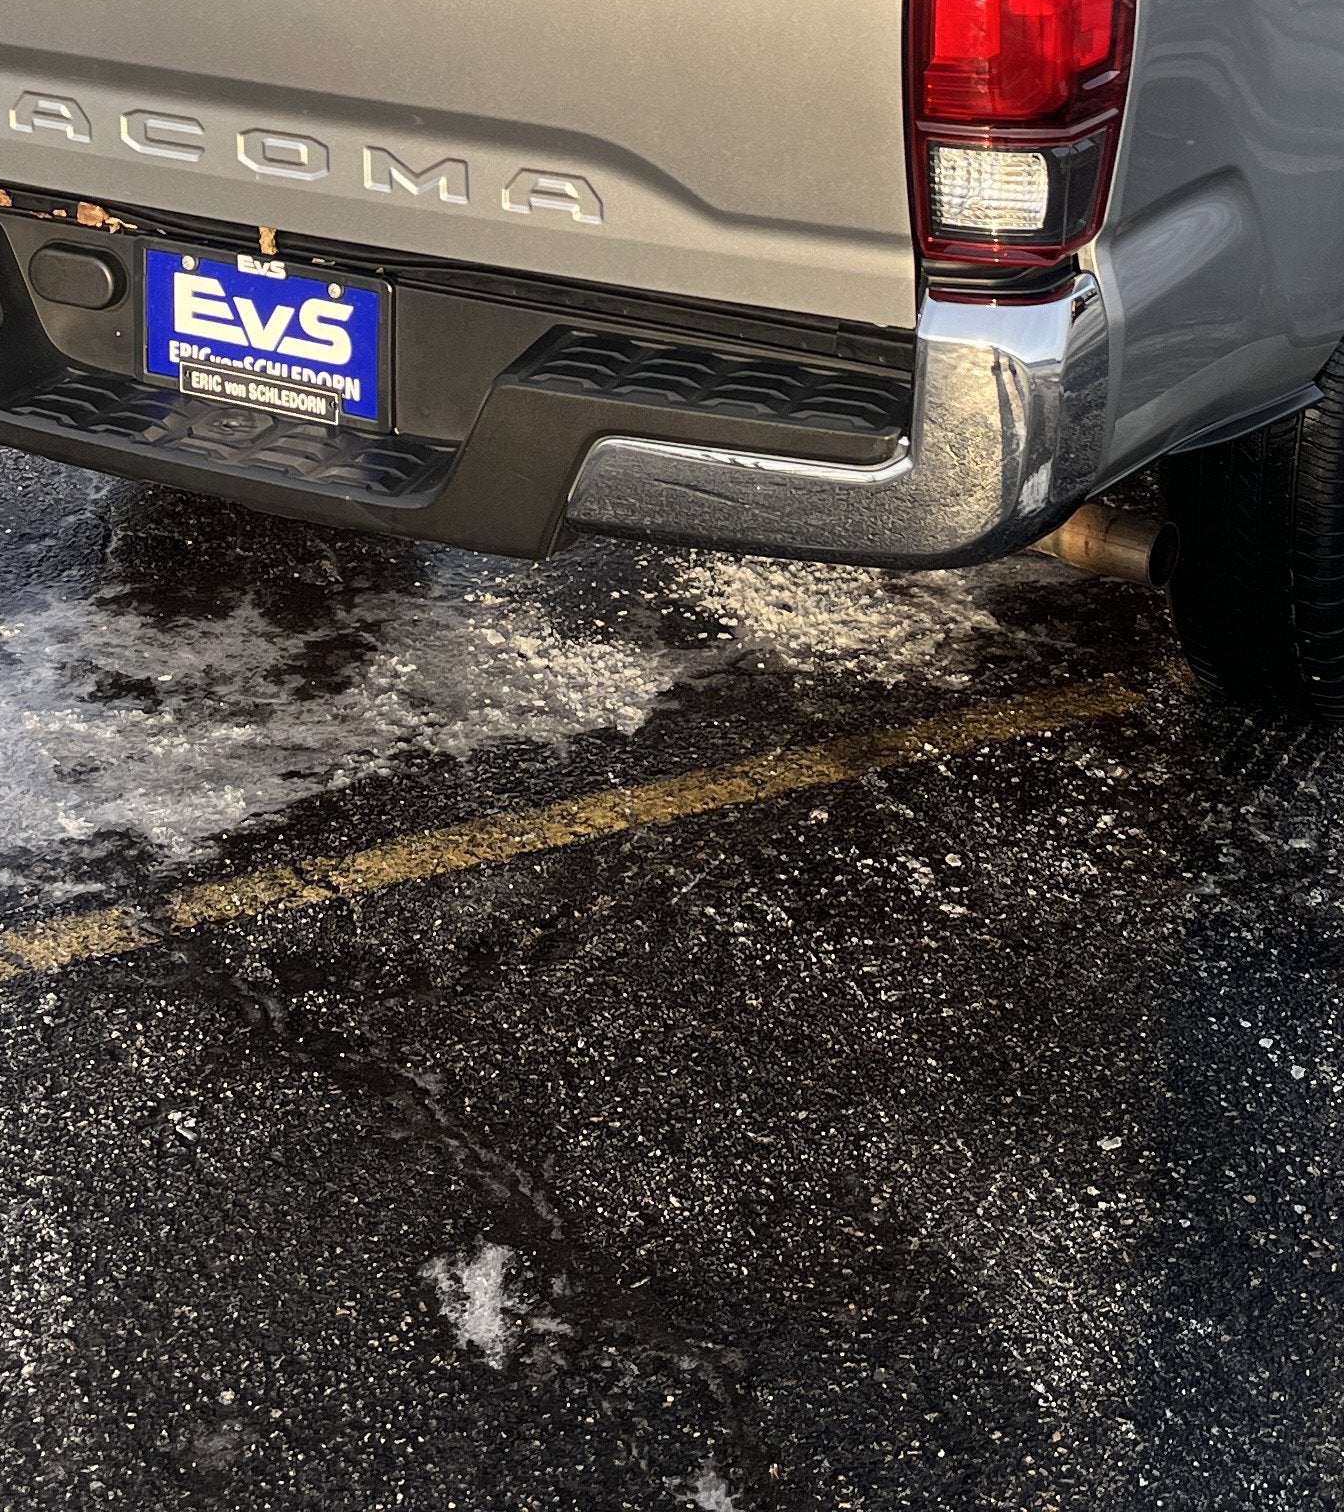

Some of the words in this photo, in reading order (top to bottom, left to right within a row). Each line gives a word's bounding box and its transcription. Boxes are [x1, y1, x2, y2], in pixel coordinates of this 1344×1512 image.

[191, 370, 222, 393] ERIC
[224, 381, 247, 398] von
[248, 383, 327, 416] SCHLEDORN
